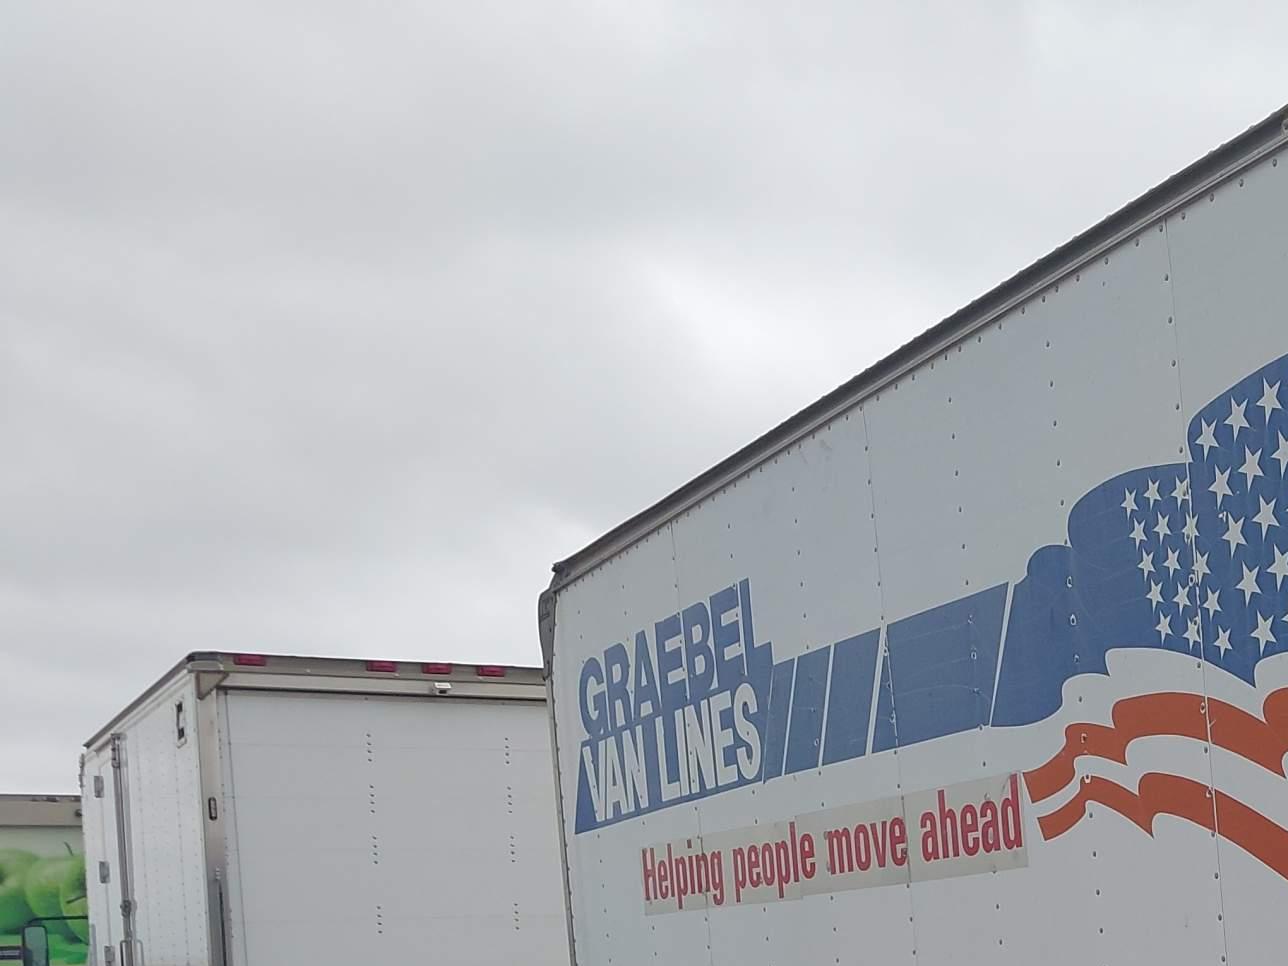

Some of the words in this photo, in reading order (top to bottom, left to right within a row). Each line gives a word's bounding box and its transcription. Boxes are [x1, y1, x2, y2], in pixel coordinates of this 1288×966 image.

[579, 576, 773, 737] GRAEBEL
[582, 723, 650, 822] VAN
[655, 682, 762, 802] LINES
[642, 838, 725, 909] Helping
[733, 821, 817, 903] people
[826, 814, 909, 876] move
[919, 773, 1025, 863] ahead
